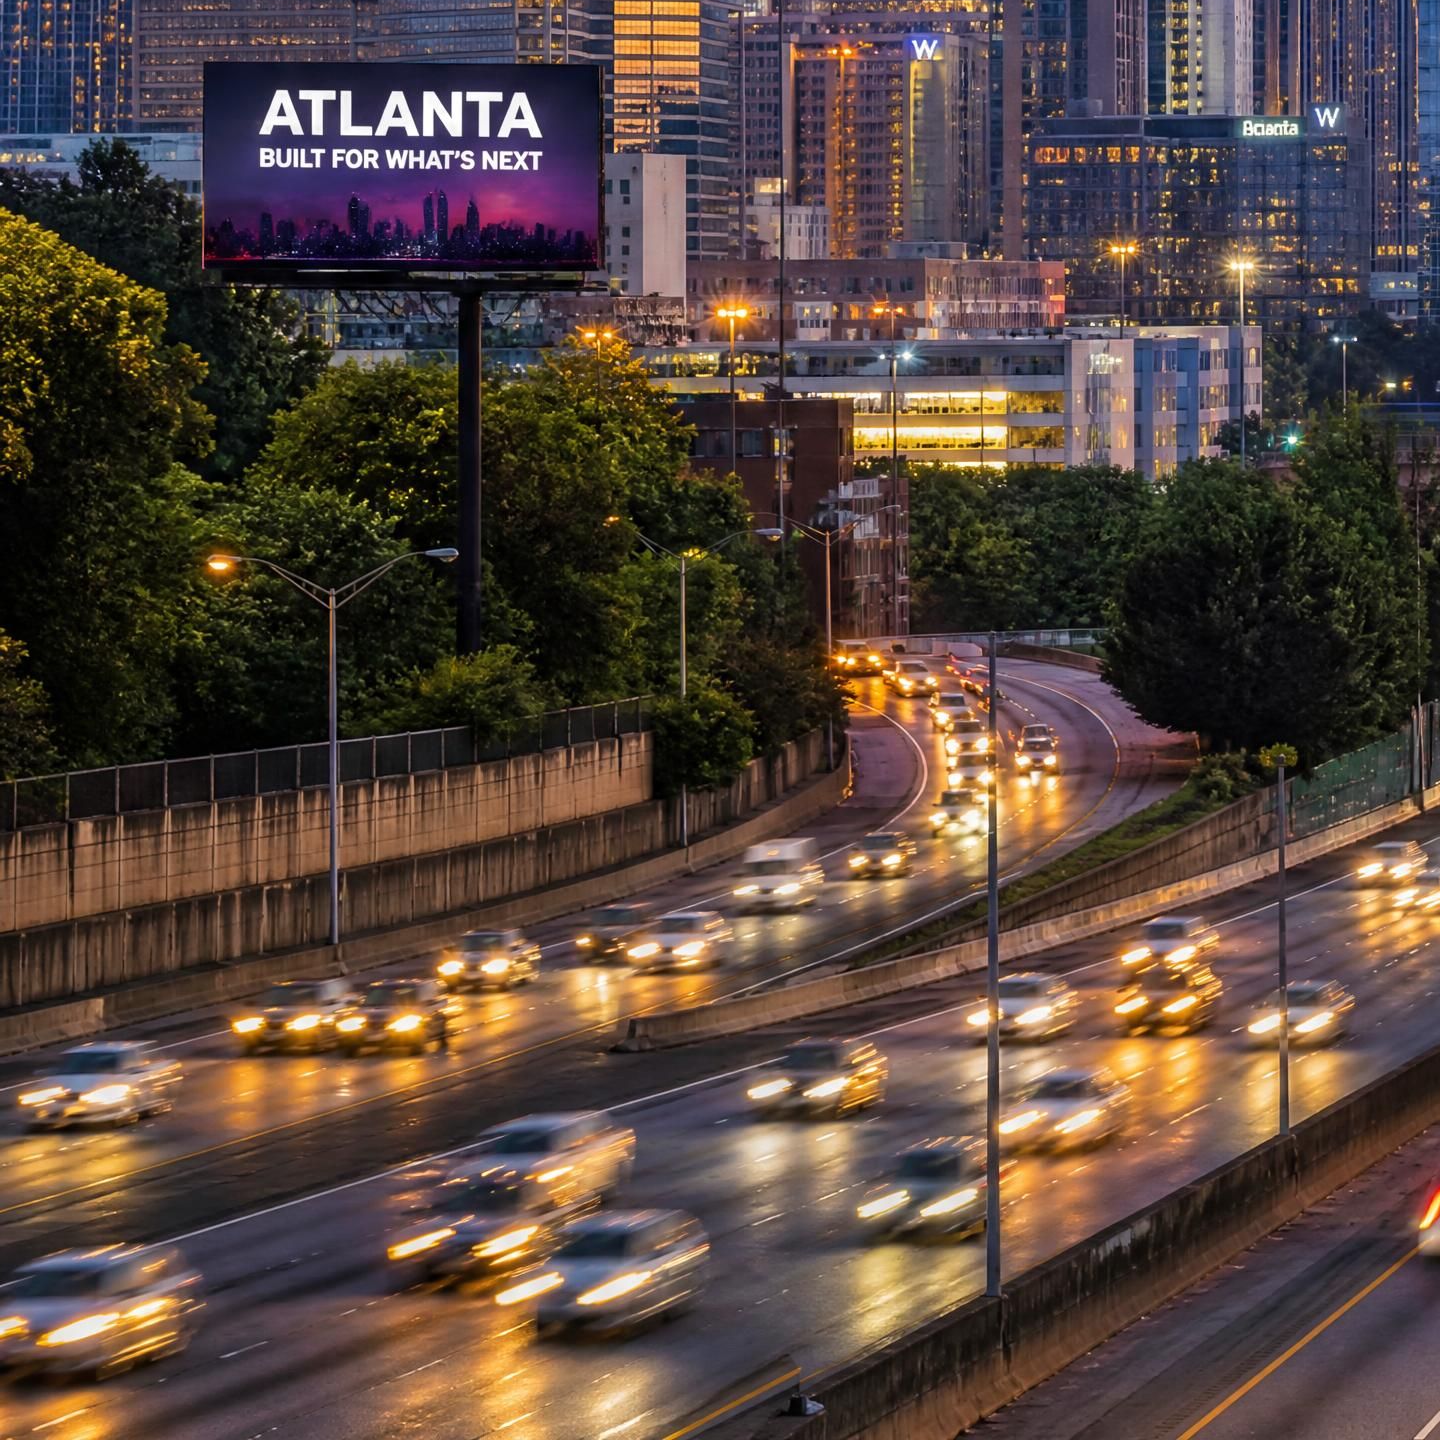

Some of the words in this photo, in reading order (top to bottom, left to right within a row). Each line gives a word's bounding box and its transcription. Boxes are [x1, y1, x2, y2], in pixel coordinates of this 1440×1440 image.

[911, 39, 938, 60] W
[259, 89, 543, 138] ATLANTA
[1314, 107, 1340, 128] W
[259, 147, 326, 168] BUILT
[332, 148, 380, 169] FOR
[385, 149, 476, 170] WHAT’S
[482, 150, 543, 171] NEXT
